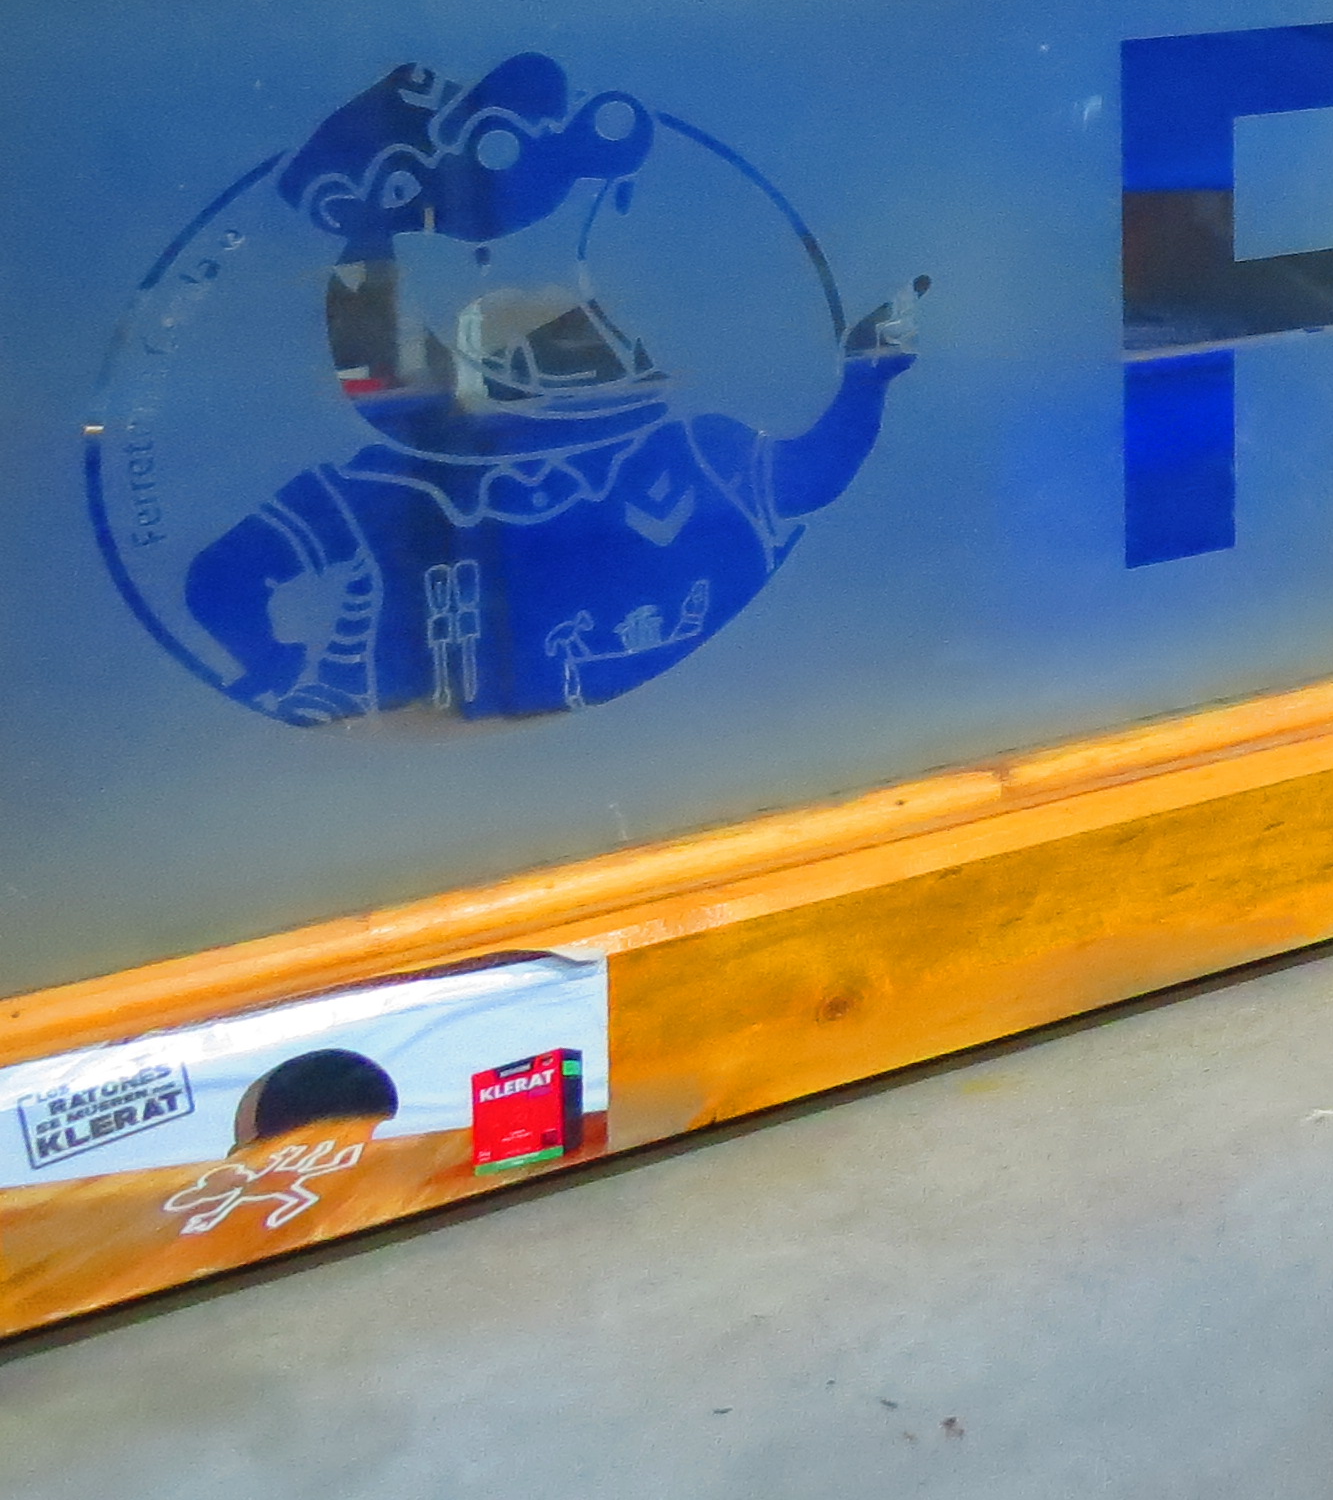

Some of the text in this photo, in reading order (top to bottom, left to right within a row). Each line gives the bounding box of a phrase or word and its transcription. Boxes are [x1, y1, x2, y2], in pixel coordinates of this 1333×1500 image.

[48, 1065, 172, 1116] RATONES
[480, 1068, 555, 1104] KLERAT
[36, 1090, 183, 1159] KLERAT
